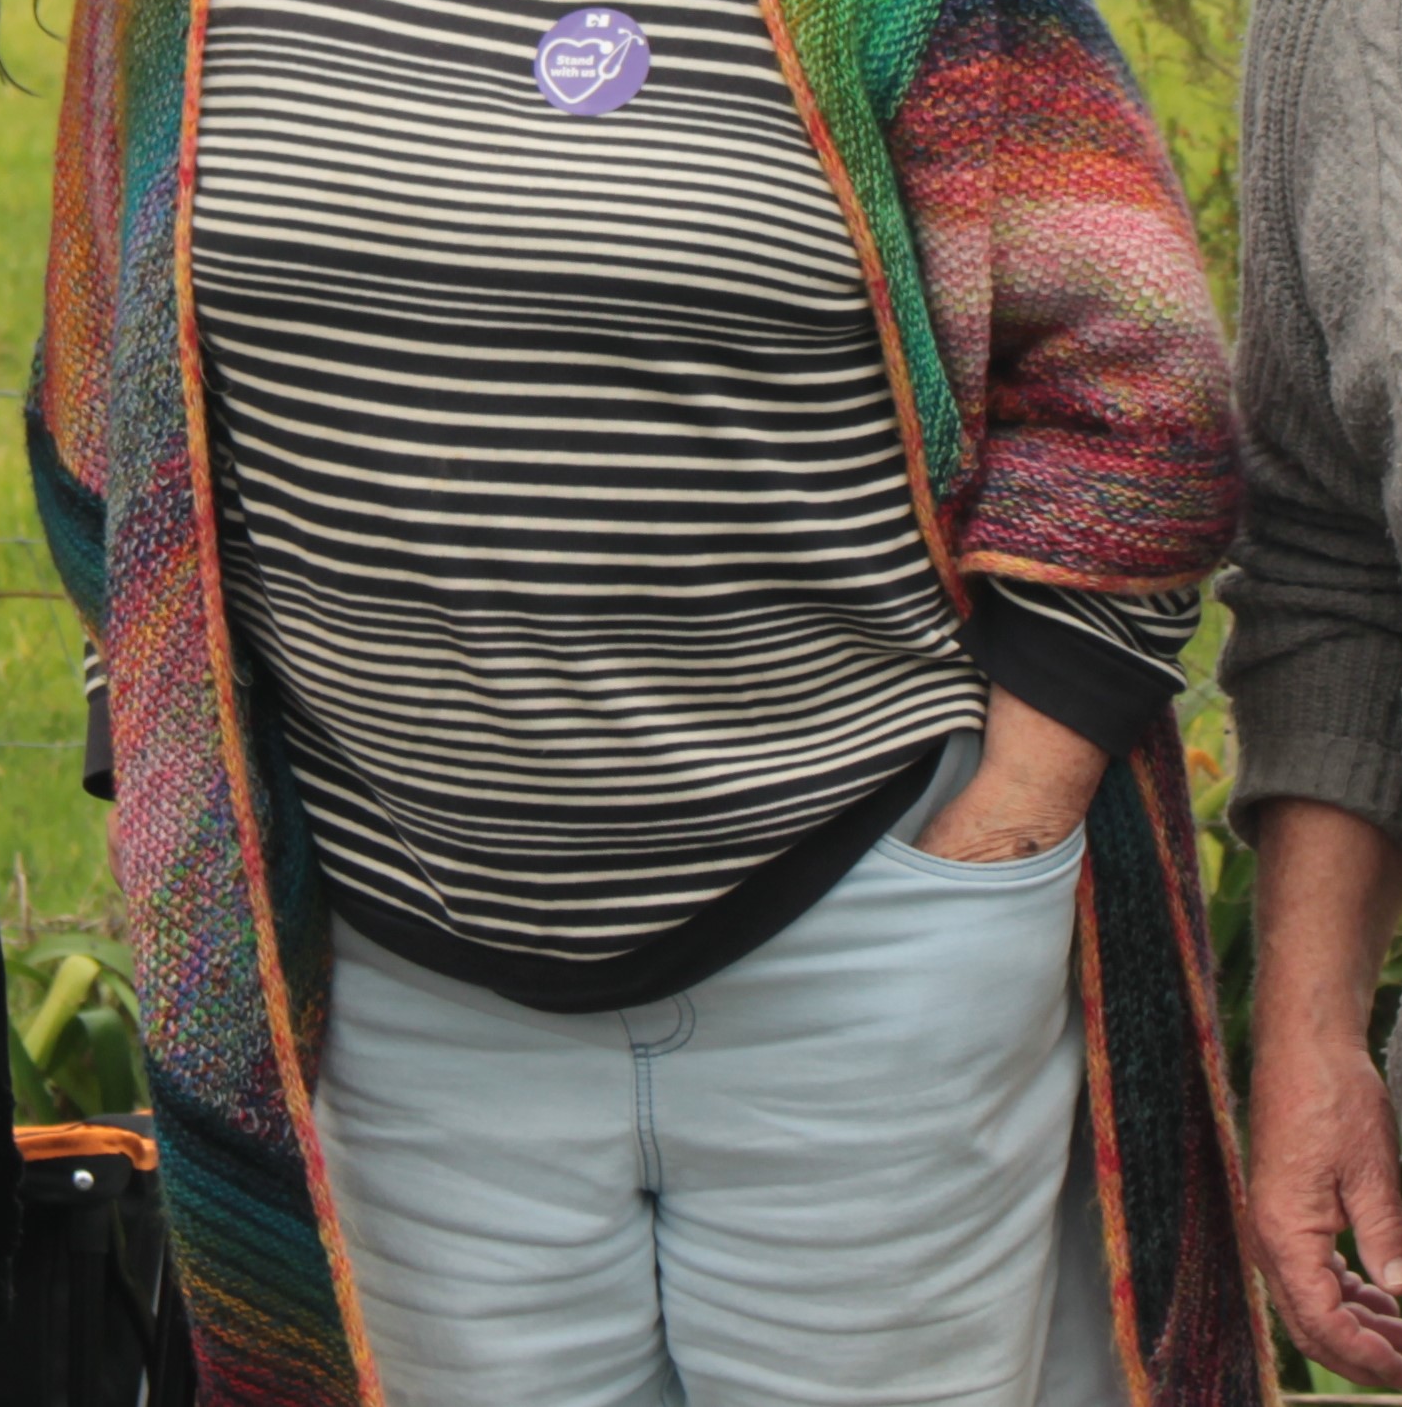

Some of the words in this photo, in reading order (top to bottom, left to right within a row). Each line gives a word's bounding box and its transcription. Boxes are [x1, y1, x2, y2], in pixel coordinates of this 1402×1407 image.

[556, 55, 595, 66] Stand
[550, 67, 579, 78] with
[581, 69, 596, 78] us
